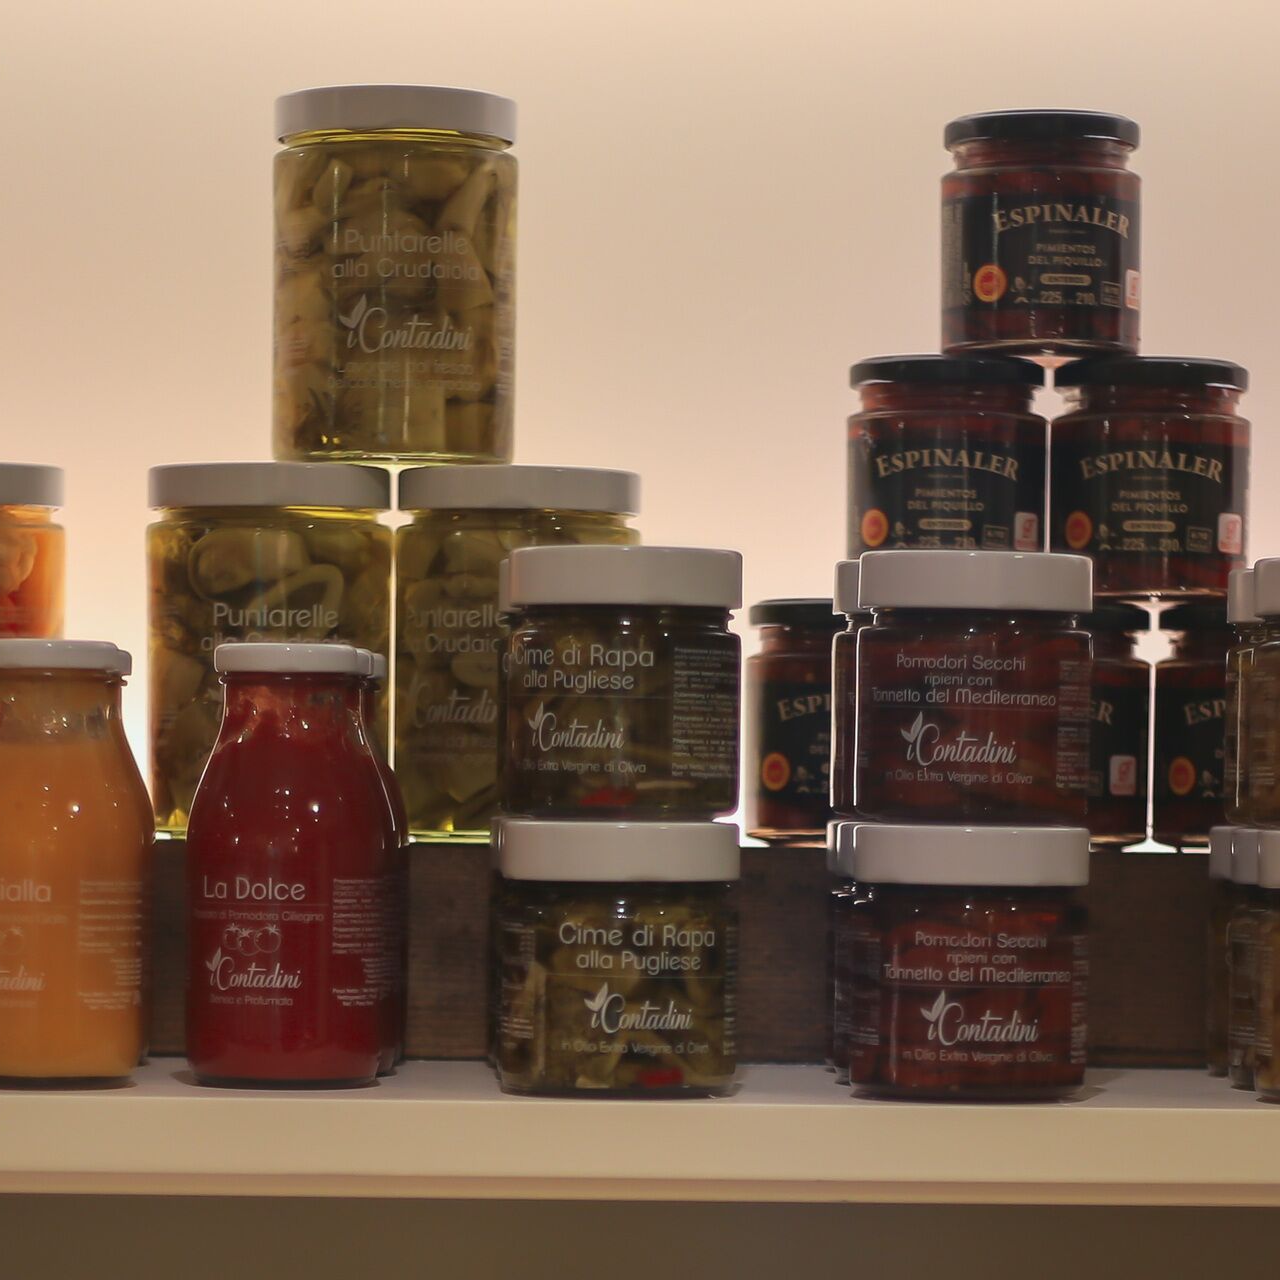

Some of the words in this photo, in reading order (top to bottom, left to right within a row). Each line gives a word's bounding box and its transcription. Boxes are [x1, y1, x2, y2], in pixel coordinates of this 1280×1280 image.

[991, 203, 1130, 240] ESPINALER
[344, 228, 471, 256] Puntarelle
[331, 259, 369, 279] alla
[377, 257, 481, 282] Crudaiola
[875, 448, 1019, 483] ESPINALER
[1079, 450, 1224, 485] ESPINALER
[213, 602, 340, 629] Puntarelle
[515, 643, 555, 666] Cime
[562, 643, 582, 666] di
[589, 643, 655, 673] Rapa
[895, 652, 968, 673] Pomodori
[971, 653, 1027, 673] Secchi
[523, 669, 548, 688] alla
[553, 669, 635, 694] Pugliese
[923, 672, 964, 689] ripieni
[966, 674, 993, 687] con
[925, 687, 951, 704] del
[954, 686, 1058, 708] Mediterraneo
[203, 874, 227, 899] La
[235, 876, 307, 901] Dolce
[558, 921, 624, 948] Cime
[631, 922, 654, 947] di
[661, 924, 717, 952] Rapa
[575, 952, 614, 970] alla
[621, 952, 703, 976] Pugliese
[991, 953, 1019, 965] con
[948, 966, 973, 983] del
